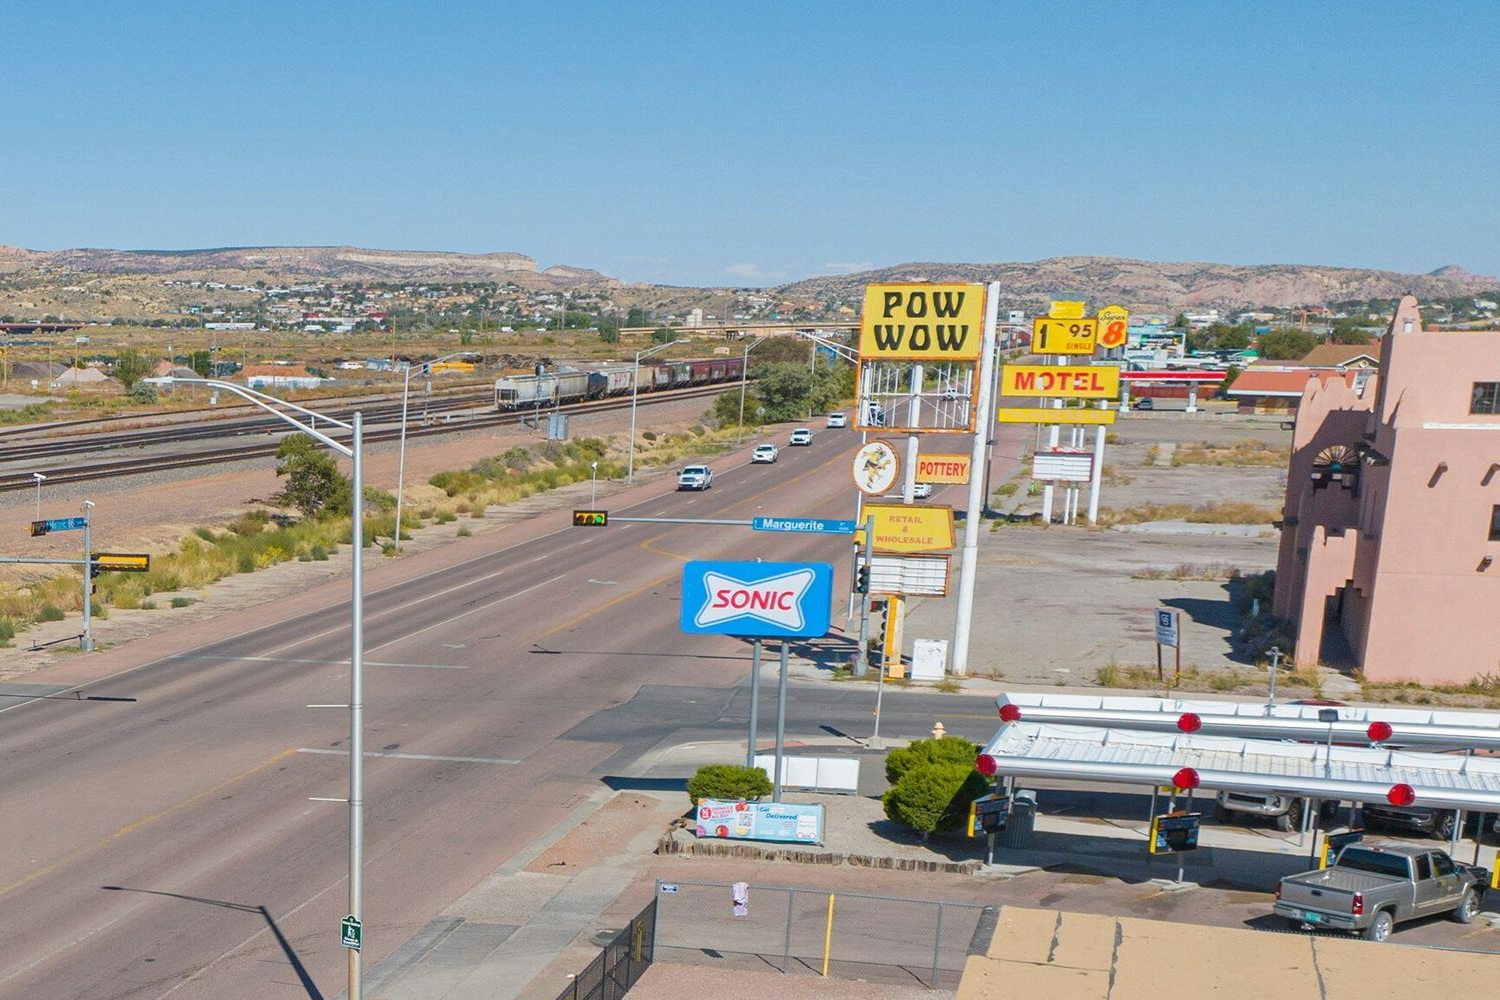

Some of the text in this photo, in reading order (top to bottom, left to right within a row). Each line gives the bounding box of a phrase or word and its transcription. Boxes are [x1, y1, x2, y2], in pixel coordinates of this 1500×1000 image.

[883, 292, 966, 318] POW
[1100, 311, 1127, 325] Super
[873, 325, 969, 351] WOW
[1069, 324, 1092, 338] 95
[1102, 321, 1125, 345] 8
[1014, 371, 1105, 391] MOTEL
[919, 462, 967, 477] POTTERY
[762, 518, 825, 531] Marguerite
[888, 515, 923, 524] RETAIL
[876, 535, 933, 545] WHOLESALE
[712, 590, 795, 611] SONIC
